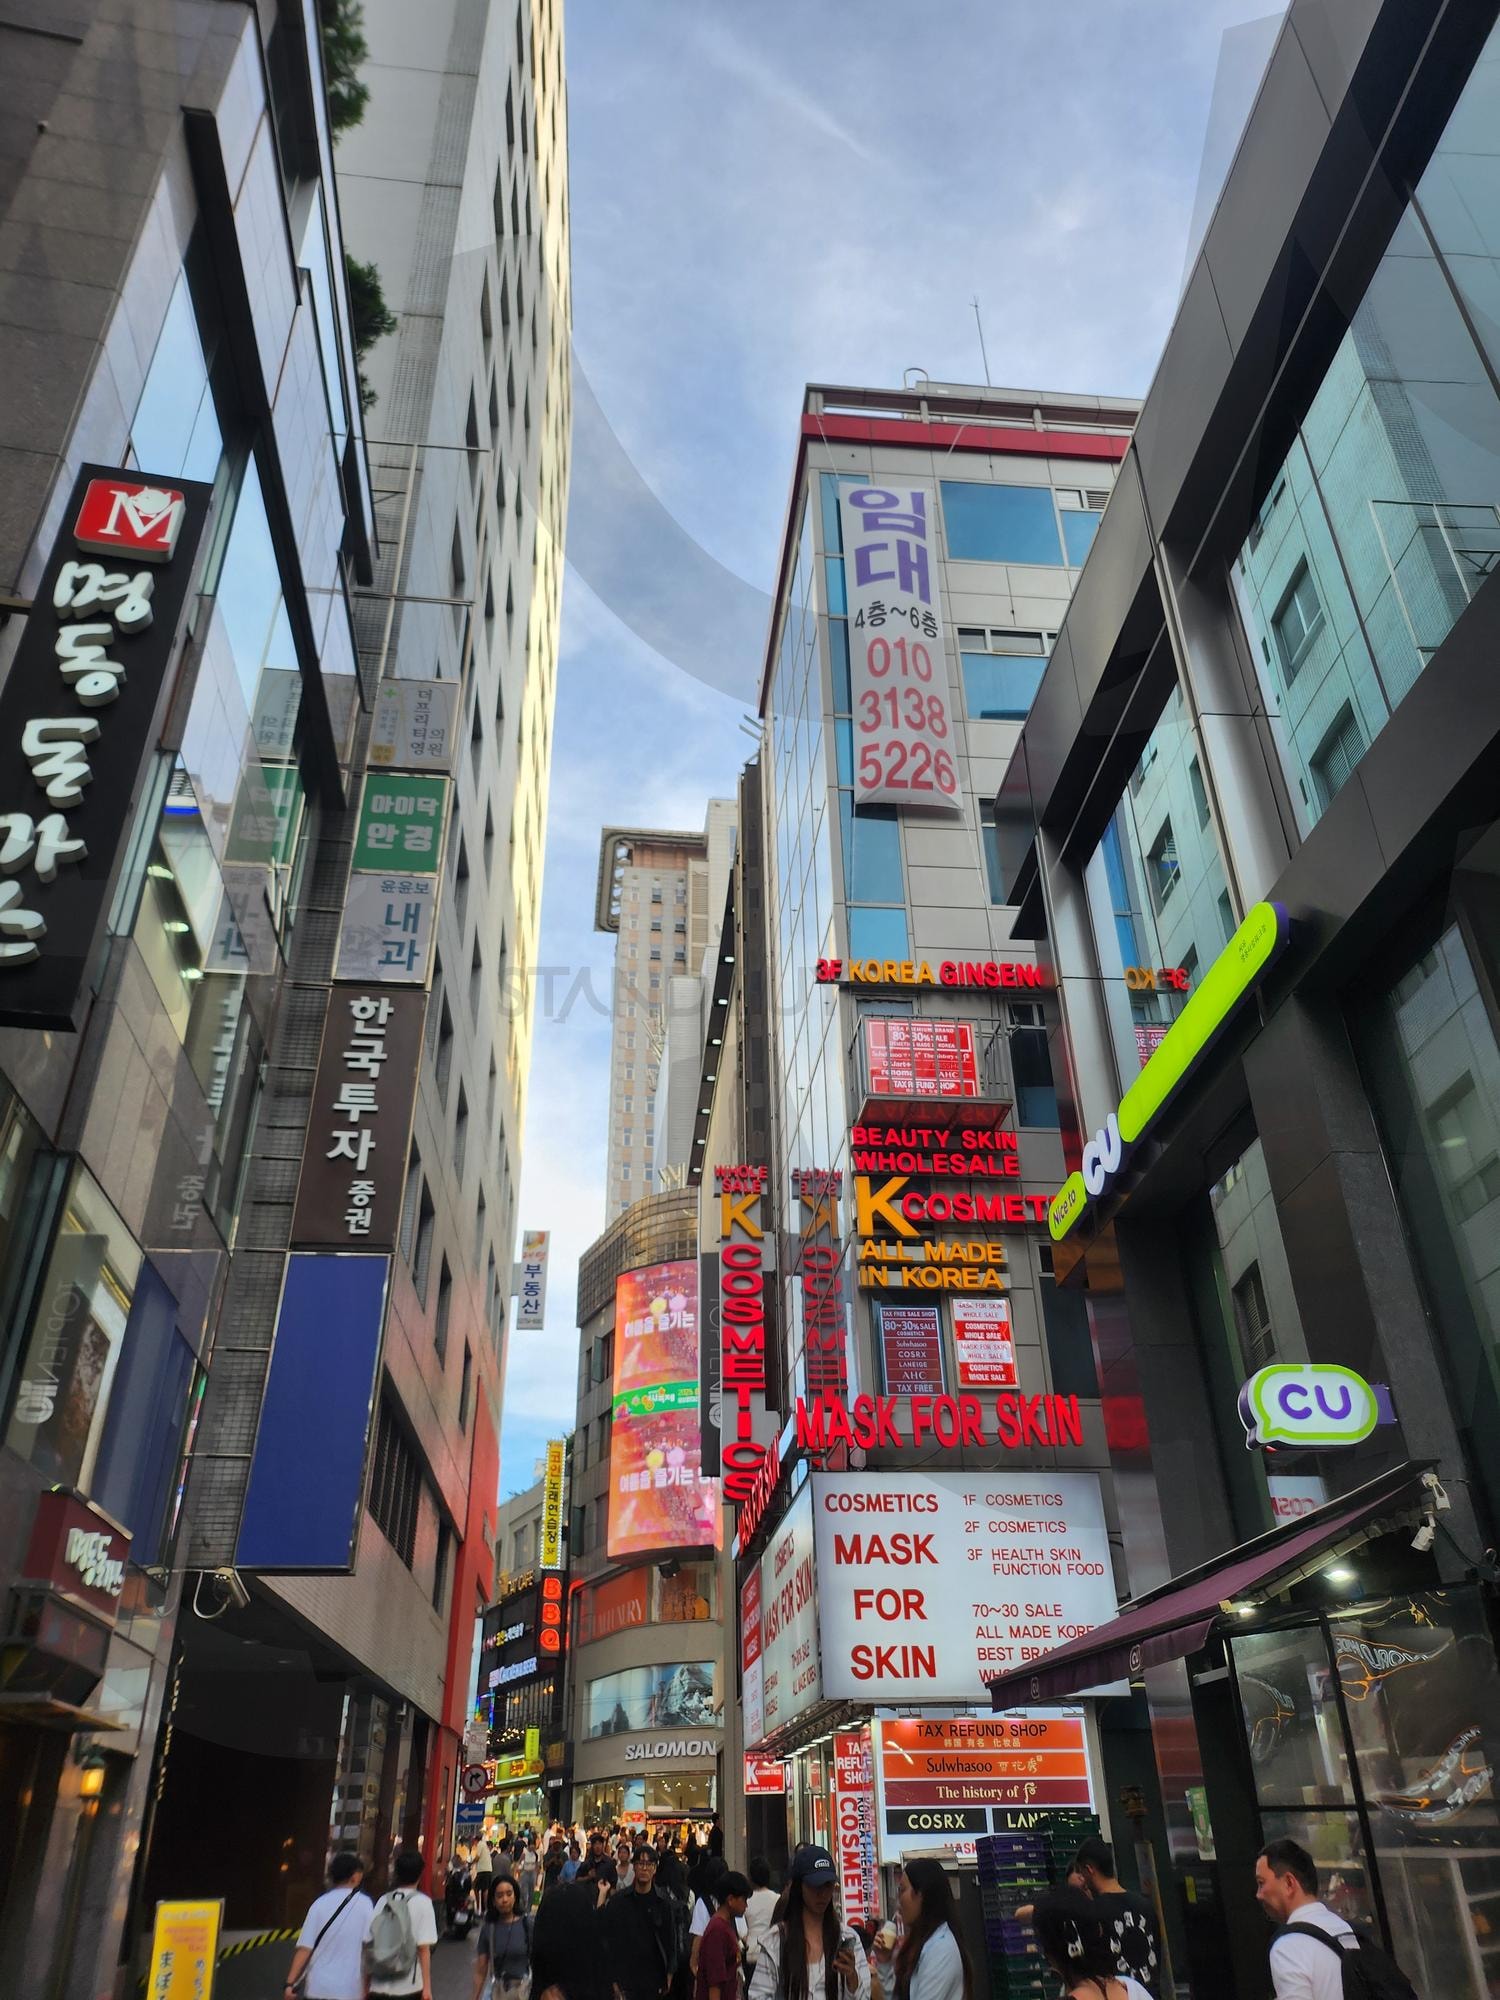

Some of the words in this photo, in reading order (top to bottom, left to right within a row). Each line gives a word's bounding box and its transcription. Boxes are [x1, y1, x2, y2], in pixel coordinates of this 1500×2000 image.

[848, 489, 931, 604] 임대
[867, 637, 933, 682] 010
[858, 686, 947, 739] 3138
[858, 740, 957, 795] 5226
[370, 794, 439, 817] 아이닥
[367, 822, 433, 851] 안경
[378, 902, 421, 971] 내과
[816, 959, 842, 982] 3F
[849, 959, 935, 984] KOREA
[326, 996, 394, 1171] 한국투자
[851, 1127, 949, 1148] BEAUTY
[962, 1129, 1017, 1150] SKIN
[852, 1150, 1020, 1176] WHOLESALE
[1083, 1113, 1121, 1195] CU
[714, 1165, 768, 1180] WHOLE
[721, 1179, 761, 1194] SALE
[344, 1180, 376, 1235] 증권
[721, 1193, 764, 1240] K
[854, 1176, 921, 1239] K
[901, 1191, 1056, 1224] COSMET
[1051, 1203, 1069, 1228] Nice
[1066, 1189, 1076, 1206] to
[860, 1239, 912, 1261] ALL
[923, 1240, 1005, 1263] MADE
[522, 1264, 542, 1314] 부동산
[859, 1265, 889, 1287] IN
[902, 1266, 1005, 1289] KOREA
[720, 1244, 767, 1501] COSMETICS
[903, 1371, 927, 1379] AHC
[914, 1385, 933, 1393] FREE
[1278, 1383, 1352, 1420] CU
[795, 1394, 903, 1450] MASK
[911, 1394, 986, 1449] FOR
[996, 1393, 1084, 1448] SKIN
[824, 1493, 939, 1513] COSMETICS
[963, 1494, 977, 1506] 1F
[985, 1494, 1063, 1506] COSMETICS
[964, 1521, 979, 1533] 2F
[988, 1521, 1066, 1533] COSMETICS
[834, 1533, 939, 1565] MASK
[967, 1549, 983, 1561] 3F
[991, 1548, 1044, 1561] HEALTH
[1049, 1548, 1081, 1561] SKIN
[993, 1564, 1061, 1575] FUNCTION
[1067, 1564, 1104, 1575] FOOD
[540, 1577, 562, 1651] BBQ
[853, 1588, 928, 1621] FOR
[972, 1604, 1019, 1618] 70~30
[1025, 1604, 1063, 1617] SALE
[975, 1626, 1003, 1639] ALL
[1009, 1625, 1052, 1639] MADE
[1057, 1625, 1096, 1639] KORE
[850, 1644, 937, 1680] SKIN
[977, 1647, 1014, 1661] BEST
[1021, 1647, 1055, 1660] BRA
[916, 1724, 944, 1737] TAX
[950, 1724, 1004, 1737] REFUND
[1010, 1724, 1048, 1737] SHOP
[624, 1740, 717, 1761] SALOMON
[846, 1741, 861, 1755] TA
[746, 1761, 759, 1785] K
[926, 1757, 992, 1773] Sulwhasoo
[936, 1785, 960, 1799] The
[963, 1785, 1003, 1801] history
[1006, 1785, 1019, 1798] of
[908, 1812, 966, 1830] COSRX
